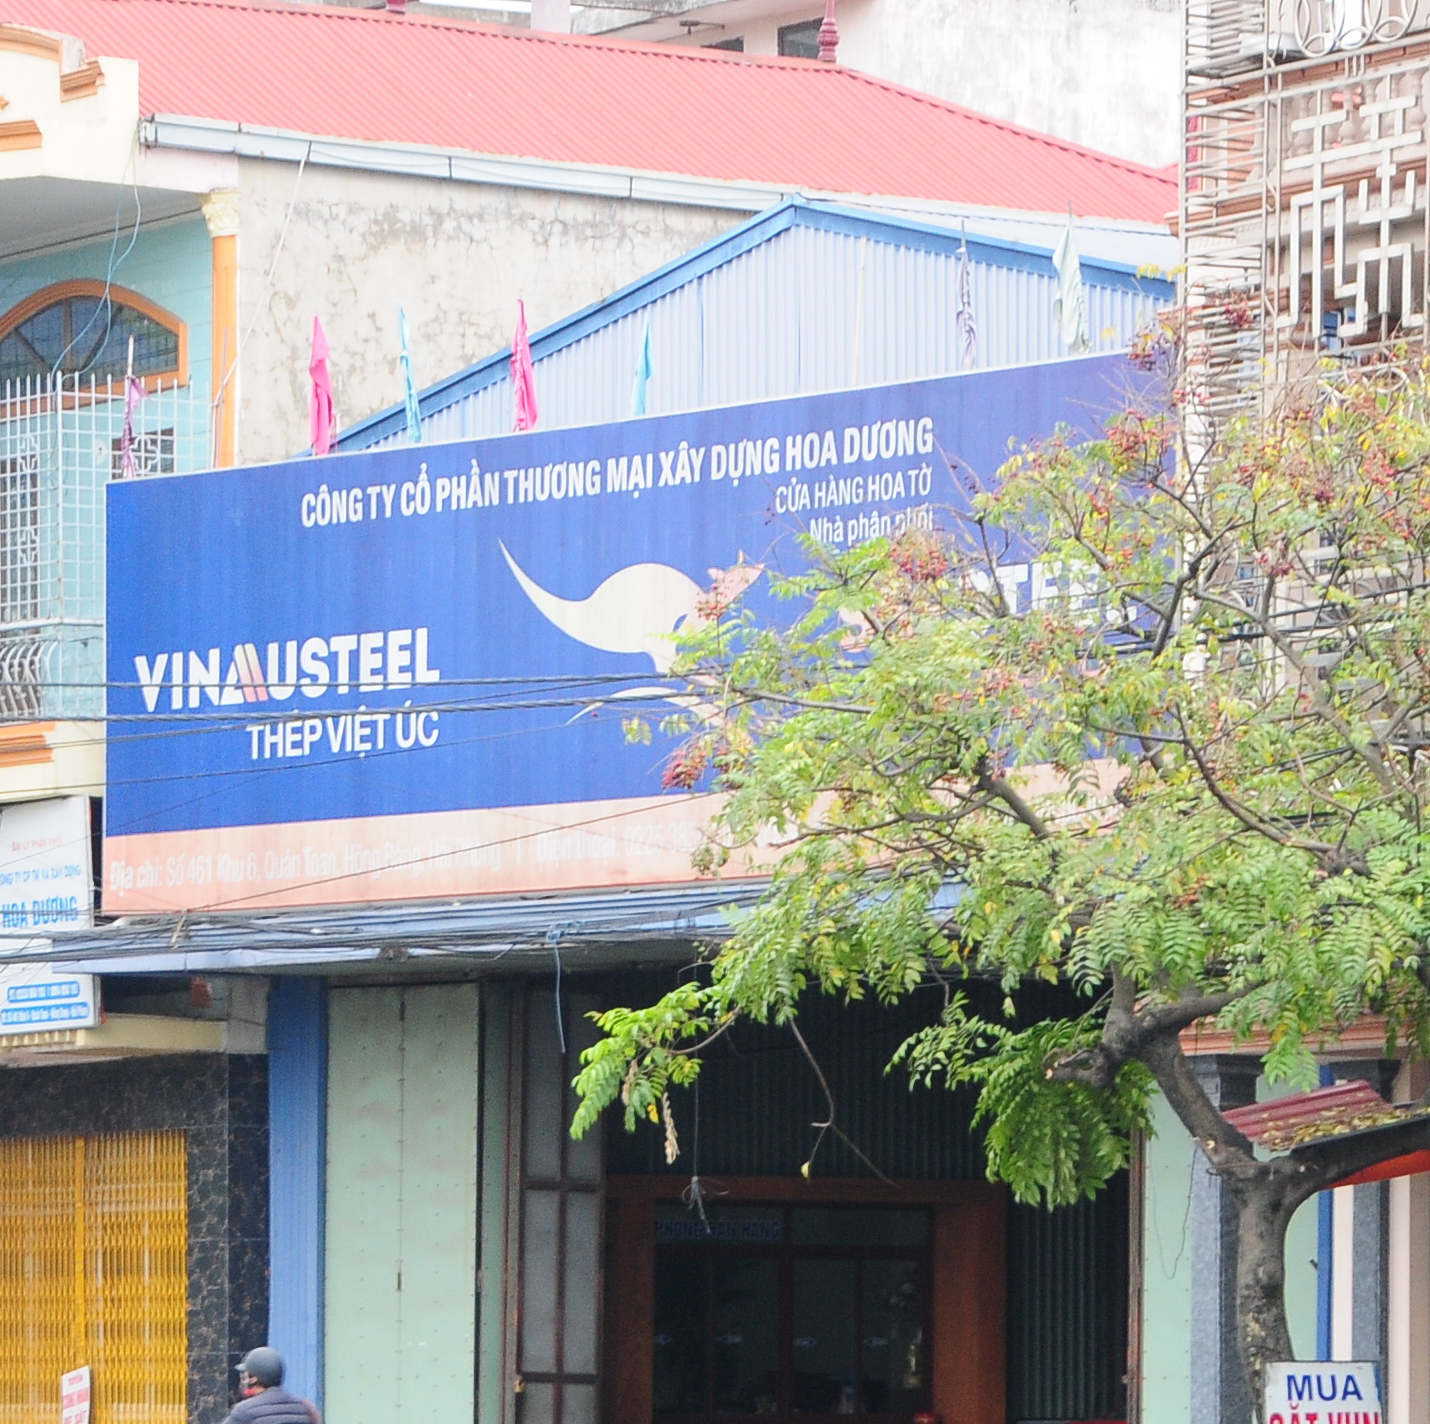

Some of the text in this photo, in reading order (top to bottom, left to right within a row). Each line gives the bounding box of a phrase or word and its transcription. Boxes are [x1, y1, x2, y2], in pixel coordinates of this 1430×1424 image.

[301, 416, 934, 527] CÔNG TY CỔ PHẦN THƯƠNG MẠI XÂY DỰNG HOA DƯƠNG
[775, 462, 933, 514] CỬA HÀNG HOA TỜ
[809, 515, 844, 543] Nhà
[847, 511, 891, 546] phân
[246, 700, 440, 760] THÉP VIỆT ÚC
[187, 854, 213, 885] 461
[217, 851, 244, 882] Khu
[1, 895, 79, 929] HOA DƯƠNG
[1286, 1373, 1364, 1402] MUA
